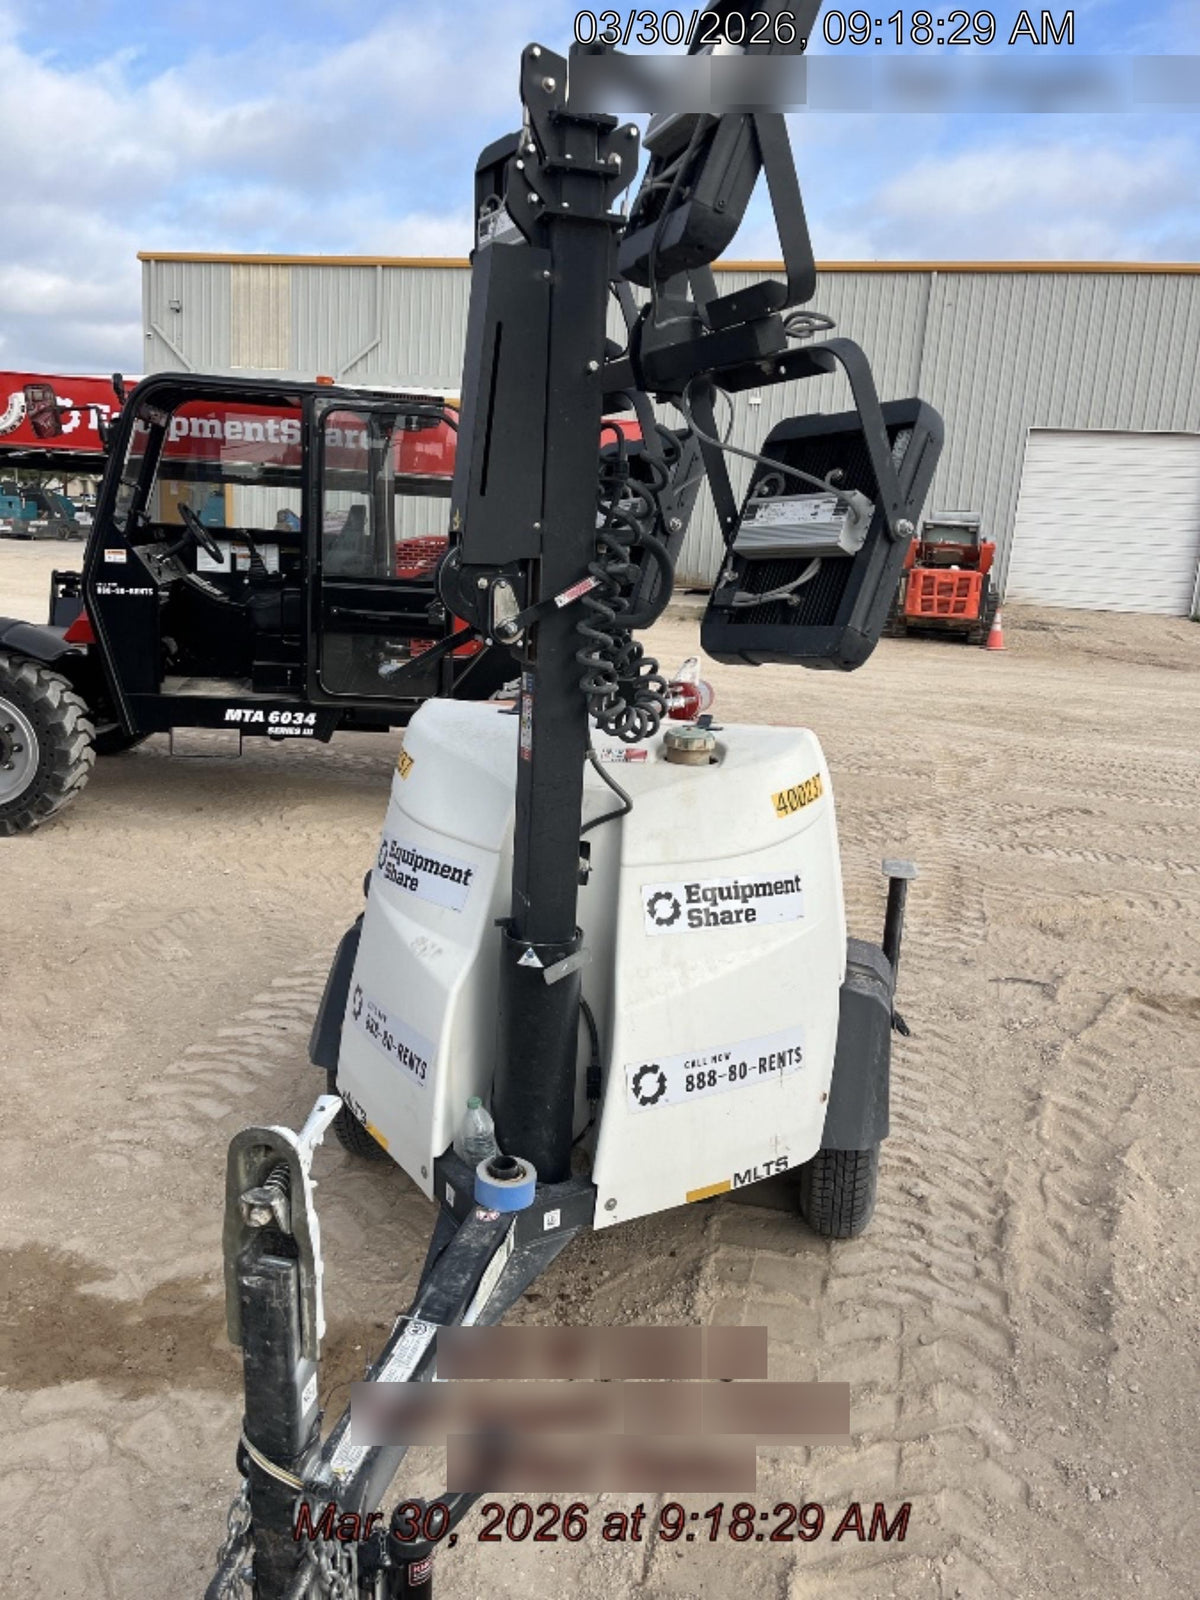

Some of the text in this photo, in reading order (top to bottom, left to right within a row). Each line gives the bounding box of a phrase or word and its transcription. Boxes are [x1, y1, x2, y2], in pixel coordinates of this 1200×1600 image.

[224, 708, 317, 726] MTA 6034
[267, 726, 301, 735] SERIES
[384, 861, 419, 892] Share
[389, 840, 473, 886] Equipment
[684, 875, 802, 908] Equipment
[687, 906, 757, 929] Share
[684, 1051, 732, 1069] CALL NOW
[685, 1045, 803, 1093] 888-80-RENTS
[733, 1155, 789, 1188] MLTS
